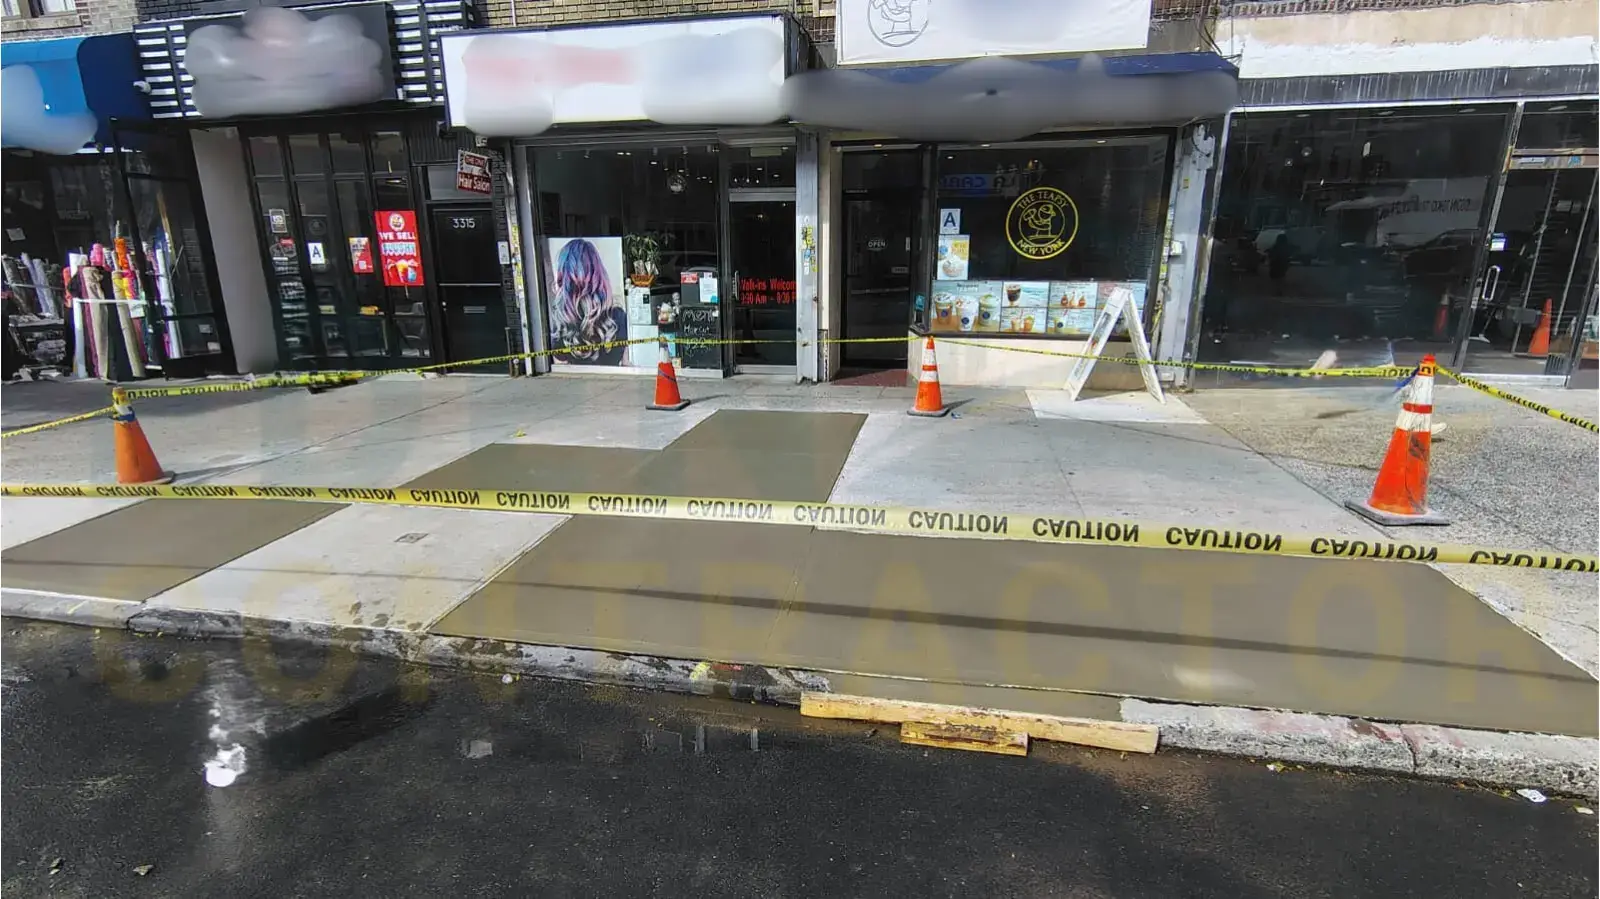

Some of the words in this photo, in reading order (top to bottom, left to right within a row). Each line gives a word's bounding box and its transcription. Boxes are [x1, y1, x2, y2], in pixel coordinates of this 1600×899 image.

[458, 173, 473, 188] Hair
[473, 176, 491, 192] Salon
[1017, 194, 1035, 209] THE
[1037, 191, 1069, 208] TEAPSY
[452, 218, 476, 229] 3315
[943, 211, 956, 228] A
[378, 231, 394, 240] WE
[396, 231, 415, 240] SELL
[868, 239, 886, 248] OPEN
[1017, 238, 1039, 255] NEW
[1040, 238, 1066, 255] YORK
[312, 245, 322, 259] A
[770, 277, 796, 291] Welcom
